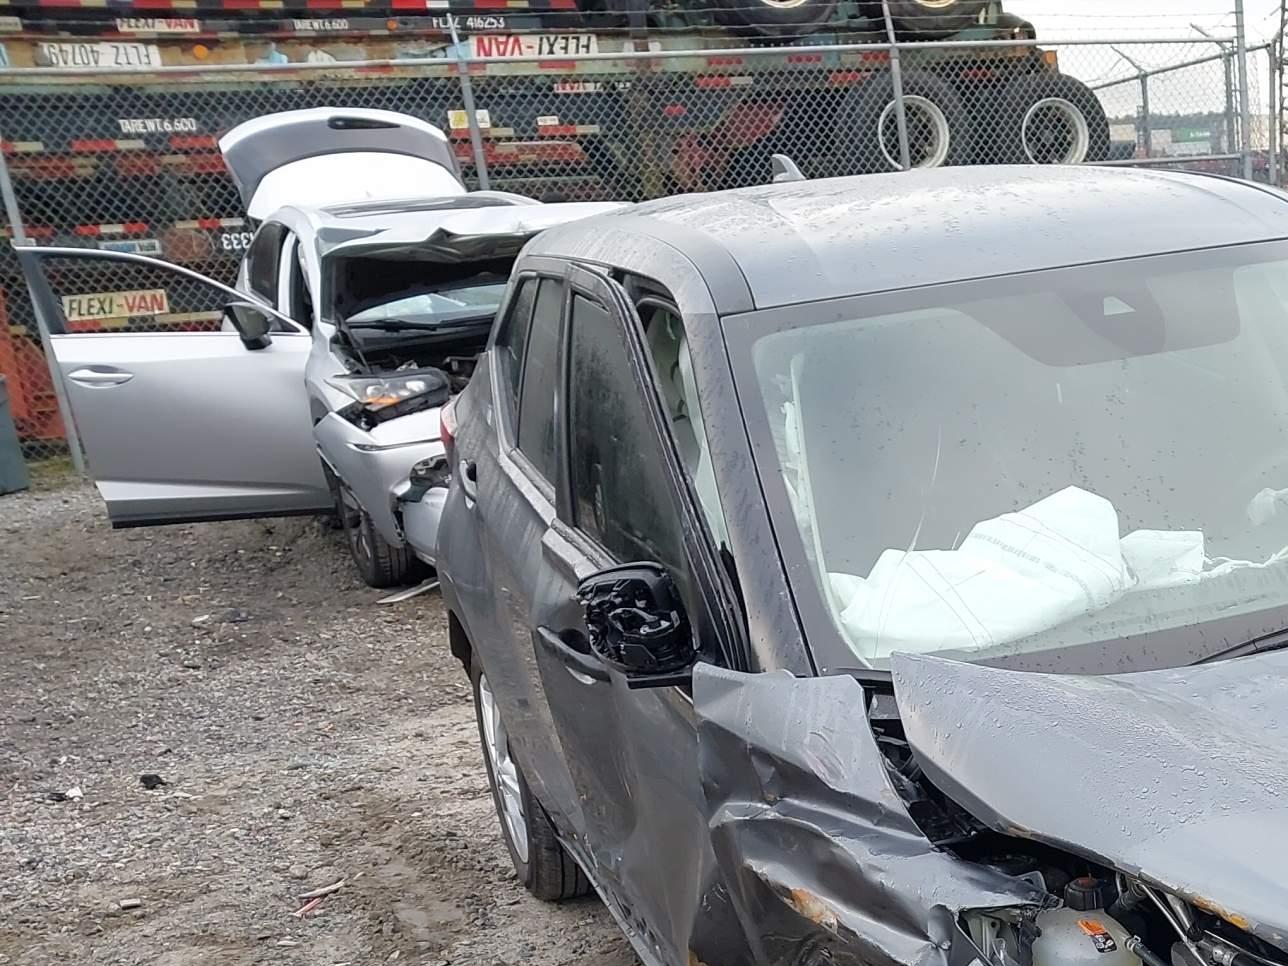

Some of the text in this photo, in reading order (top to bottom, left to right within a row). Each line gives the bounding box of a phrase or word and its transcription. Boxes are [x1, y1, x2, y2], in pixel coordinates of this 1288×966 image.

[466, 16, 506, 28] 416253
[111, 44, 151, 65] FLTZ
[475, 35, 592, 57] FLEXI-VAN
[68, 293, 164, 317] FLEXI-VAN
